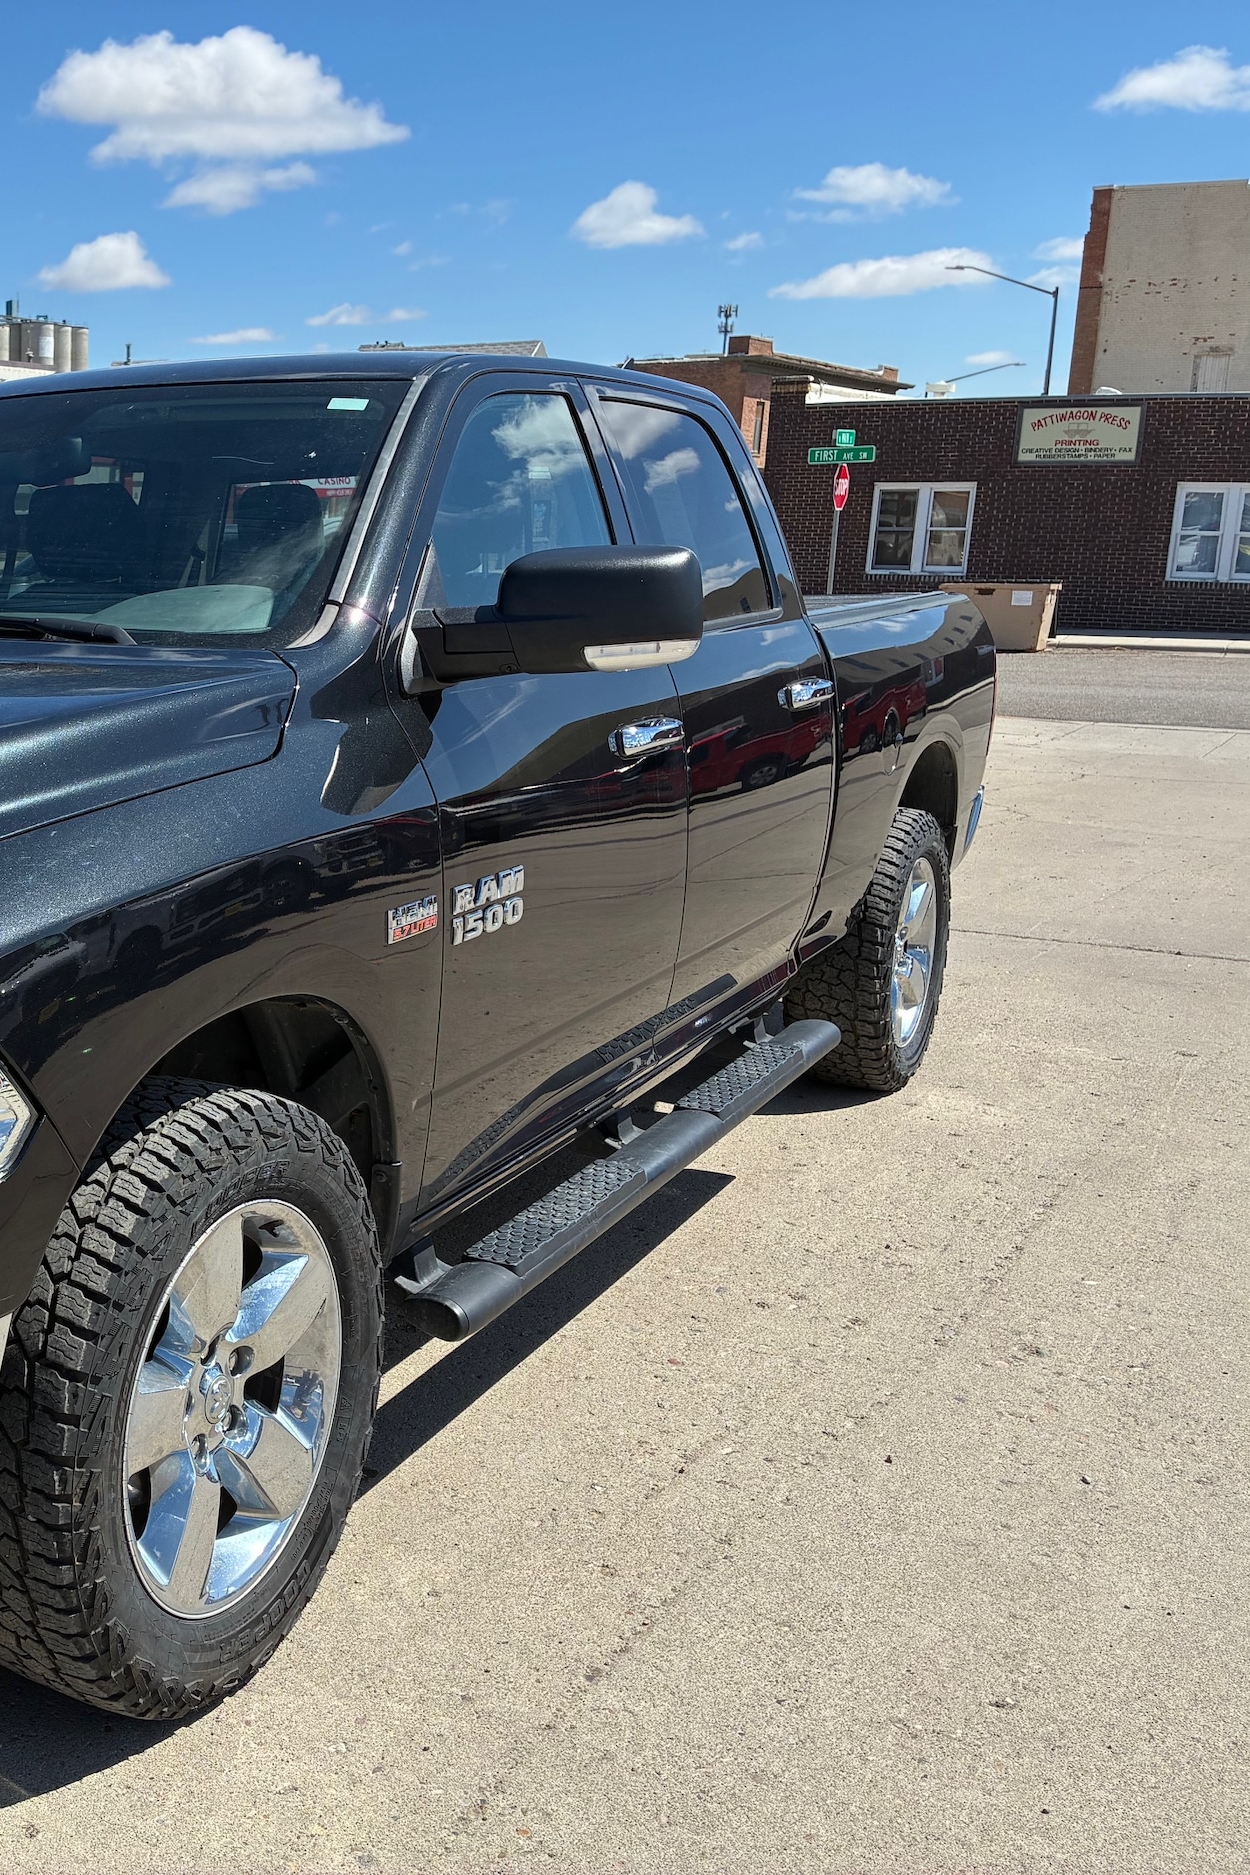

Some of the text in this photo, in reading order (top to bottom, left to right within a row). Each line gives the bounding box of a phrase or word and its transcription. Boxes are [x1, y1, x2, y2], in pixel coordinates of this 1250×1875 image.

[1030, 410, 1131, 431] PATTIWAGON PRESS
[1054, 439, 1100, 447] PRINTING
[814, 450, 838, 462] FIRST
[842, 452, 854, 460] AVE
[317, 477, 351, 485] CASINO
[835, 478, 849, 496] STOP
[452, 865, 525, 915] RAM
[392, 895, 438, 926] HEMI
[452, 896, 524, 945] 1500
[393, 914, 438, 940] 5.7 LITER
[220, 1559, 311, 1663] COOPER
